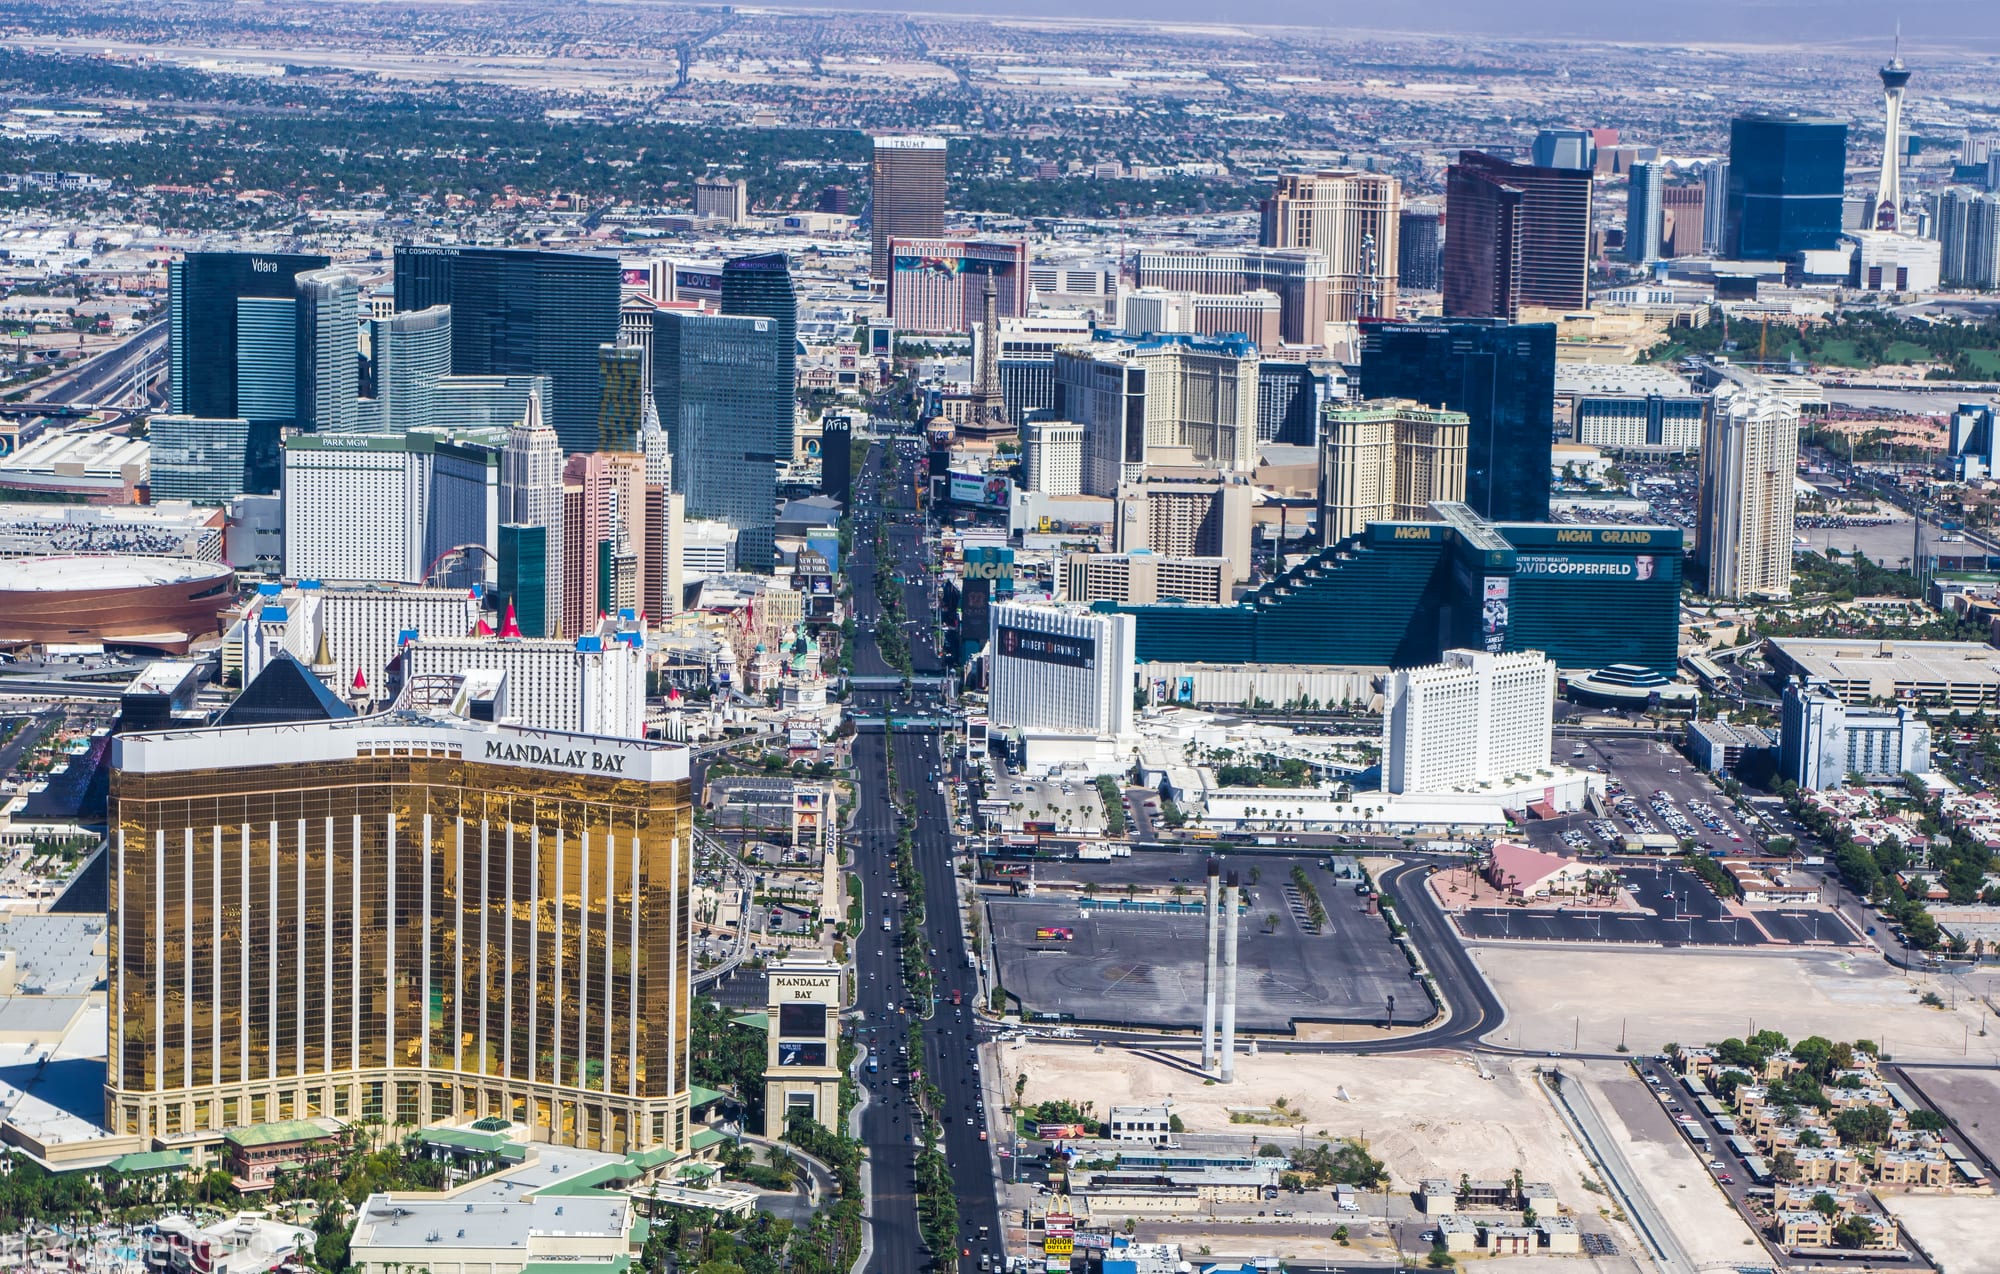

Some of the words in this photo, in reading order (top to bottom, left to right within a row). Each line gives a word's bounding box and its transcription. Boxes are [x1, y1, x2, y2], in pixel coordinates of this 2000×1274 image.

[894, 140, 925, 148] TRUMP
[395, 247, 407, 255] THE
[408, 248, 460, 256] COSMOPOLITAN
[251, 257, 278, 272] Vdara
[686, 273, 711, 287] LOVE
[825, 418, 849, 431] Aria
[322, 438, 344, 447] PARK
[346, 439, 368, 448] MGM
[1394, 526, 1431, 539] MGM
[1556, 530, 1593, 543] MGM
[1601, 531, 1651, 544] GRAND
[962, 562, 1014, 579] MGM
[484, 740, 588, 769] MANDALAY
[591, 751, 626, 773] BAY
[826, 818, 835, 856] LUXOR
[776, 977, 831, 987] MANDALAY
[794, 990, 813, 999] BAY
[1045, 1237, 1073, 1245] LIQUOR
